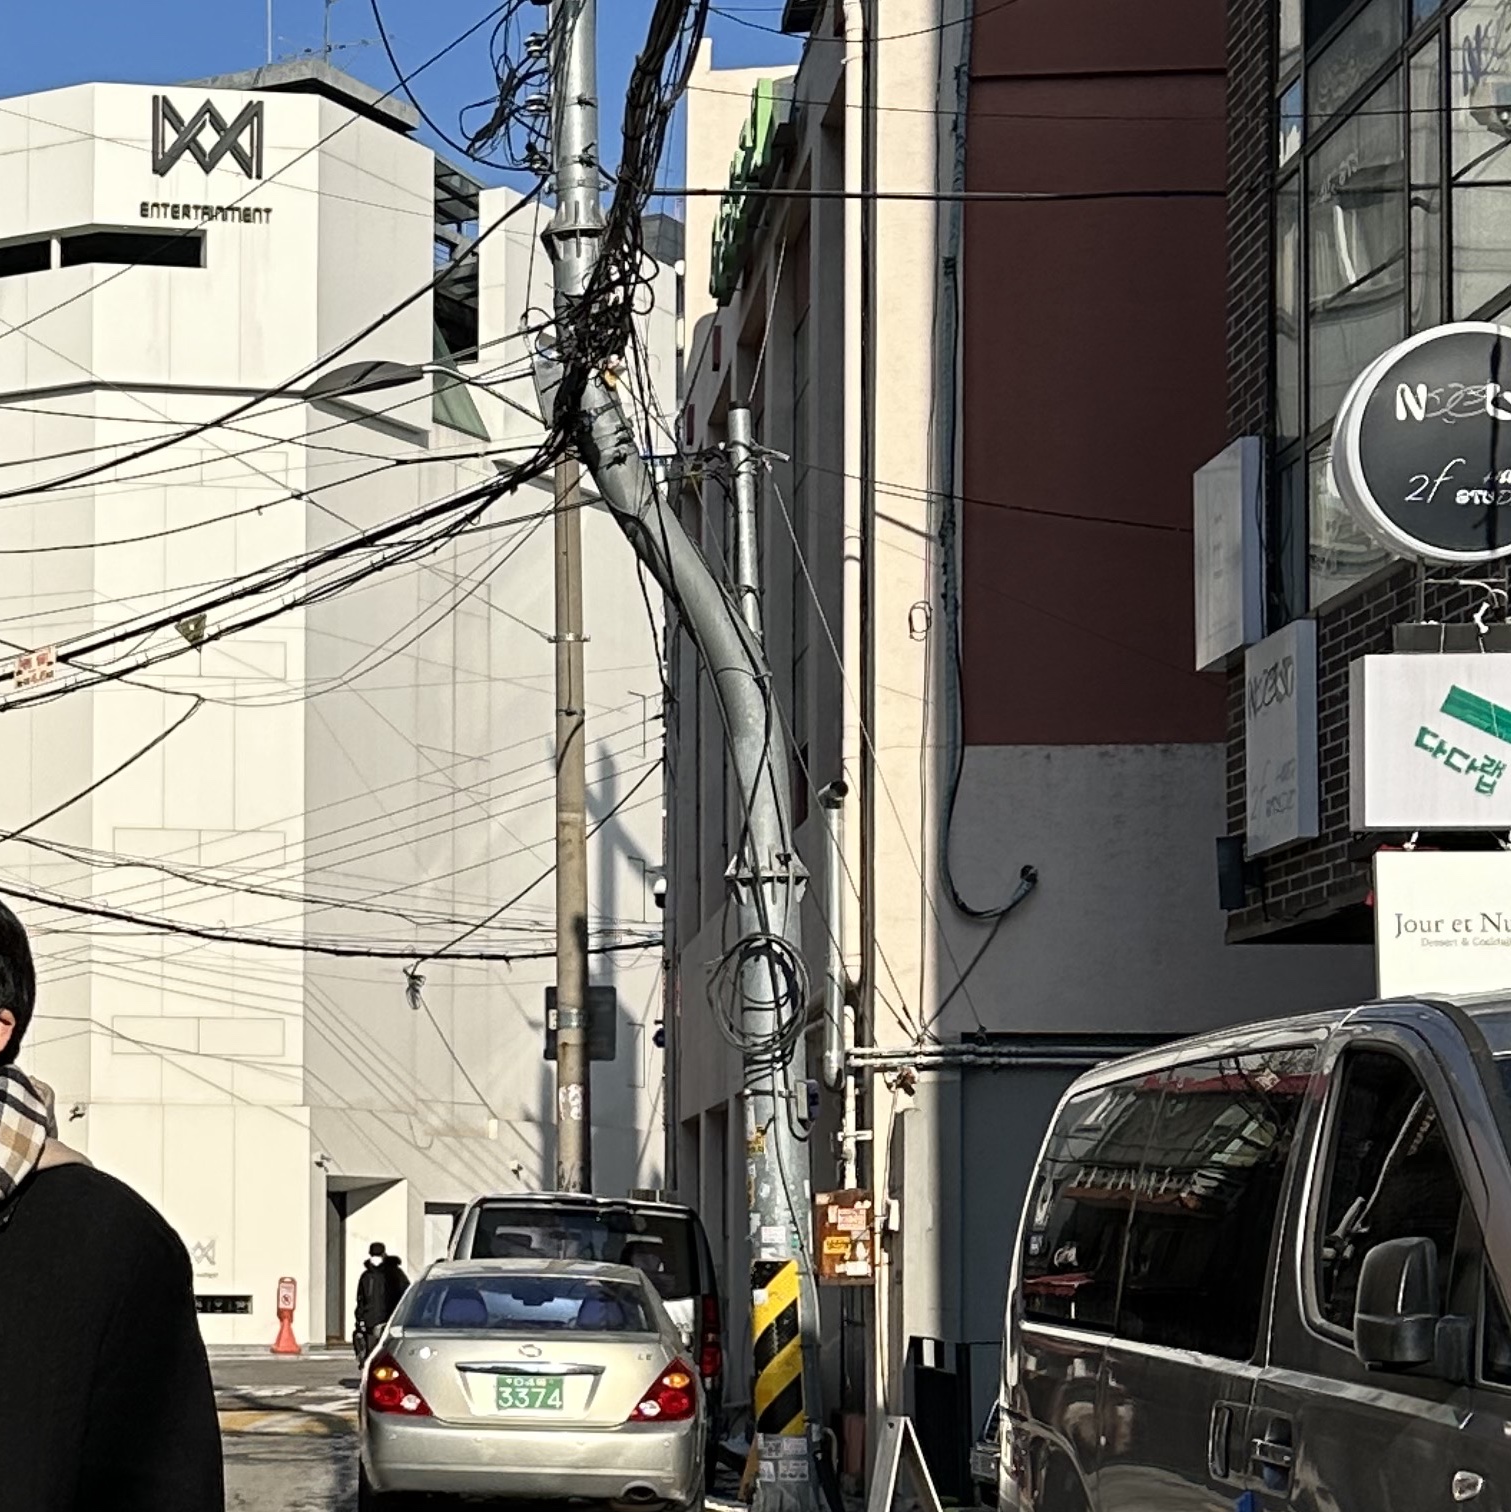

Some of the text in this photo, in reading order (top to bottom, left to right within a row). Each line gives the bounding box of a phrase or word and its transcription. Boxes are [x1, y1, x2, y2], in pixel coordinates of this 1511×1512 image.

[1414, 725, 1507, 798] 다다랩
[1394, 912, 1445, 939] Jour
[1451, 918, 1474, 933] et
[498, 1386, 563, 1409] 3374
